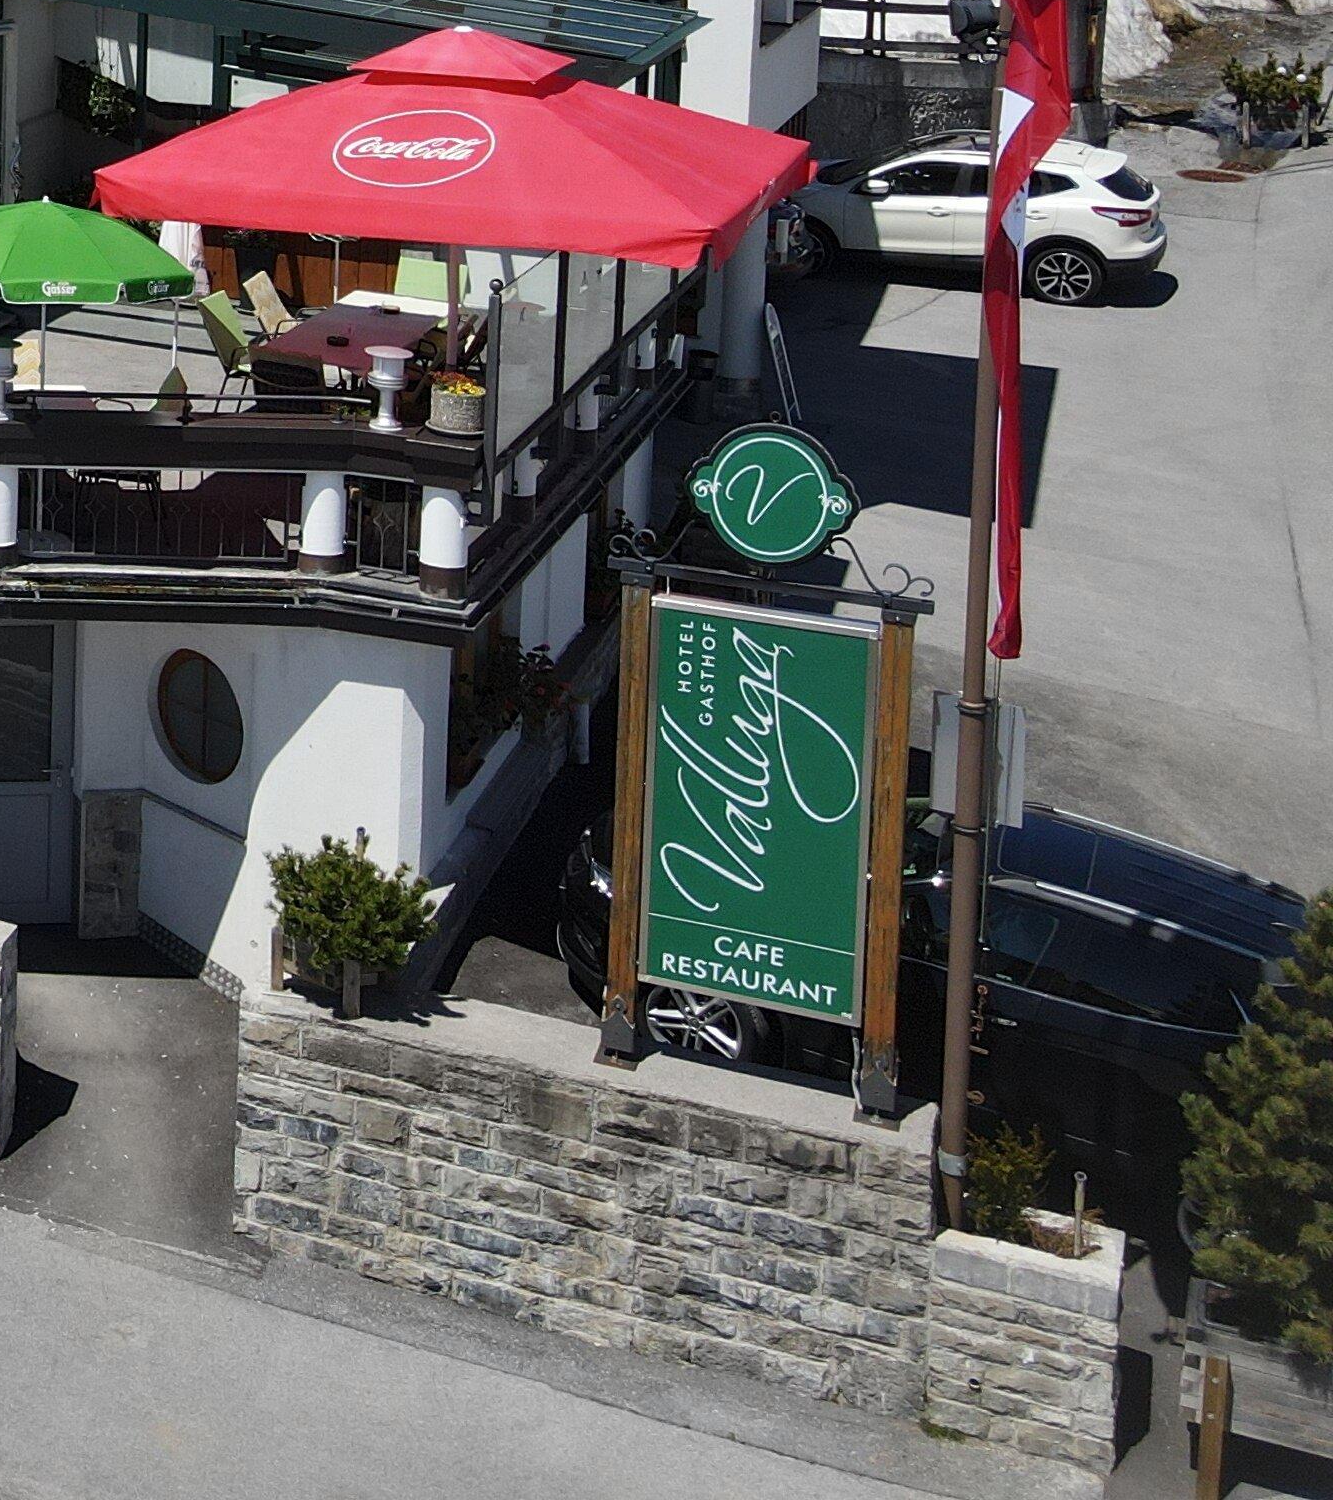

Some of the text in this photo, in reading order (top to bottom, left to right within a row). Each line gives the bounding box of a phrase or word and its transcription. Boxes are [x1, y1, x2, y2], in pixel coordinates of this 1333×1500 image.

[342, 136, 488, 161] Coca-Cola
[677, 620, 694, 693] HOTEL
[698, 621, 719, 727] GASTHOF
[660, 626, 860, 913] Valluga
[661, 952, 837, 1005] RESTAURANT
[714, 936, 784, 967] CAFE
